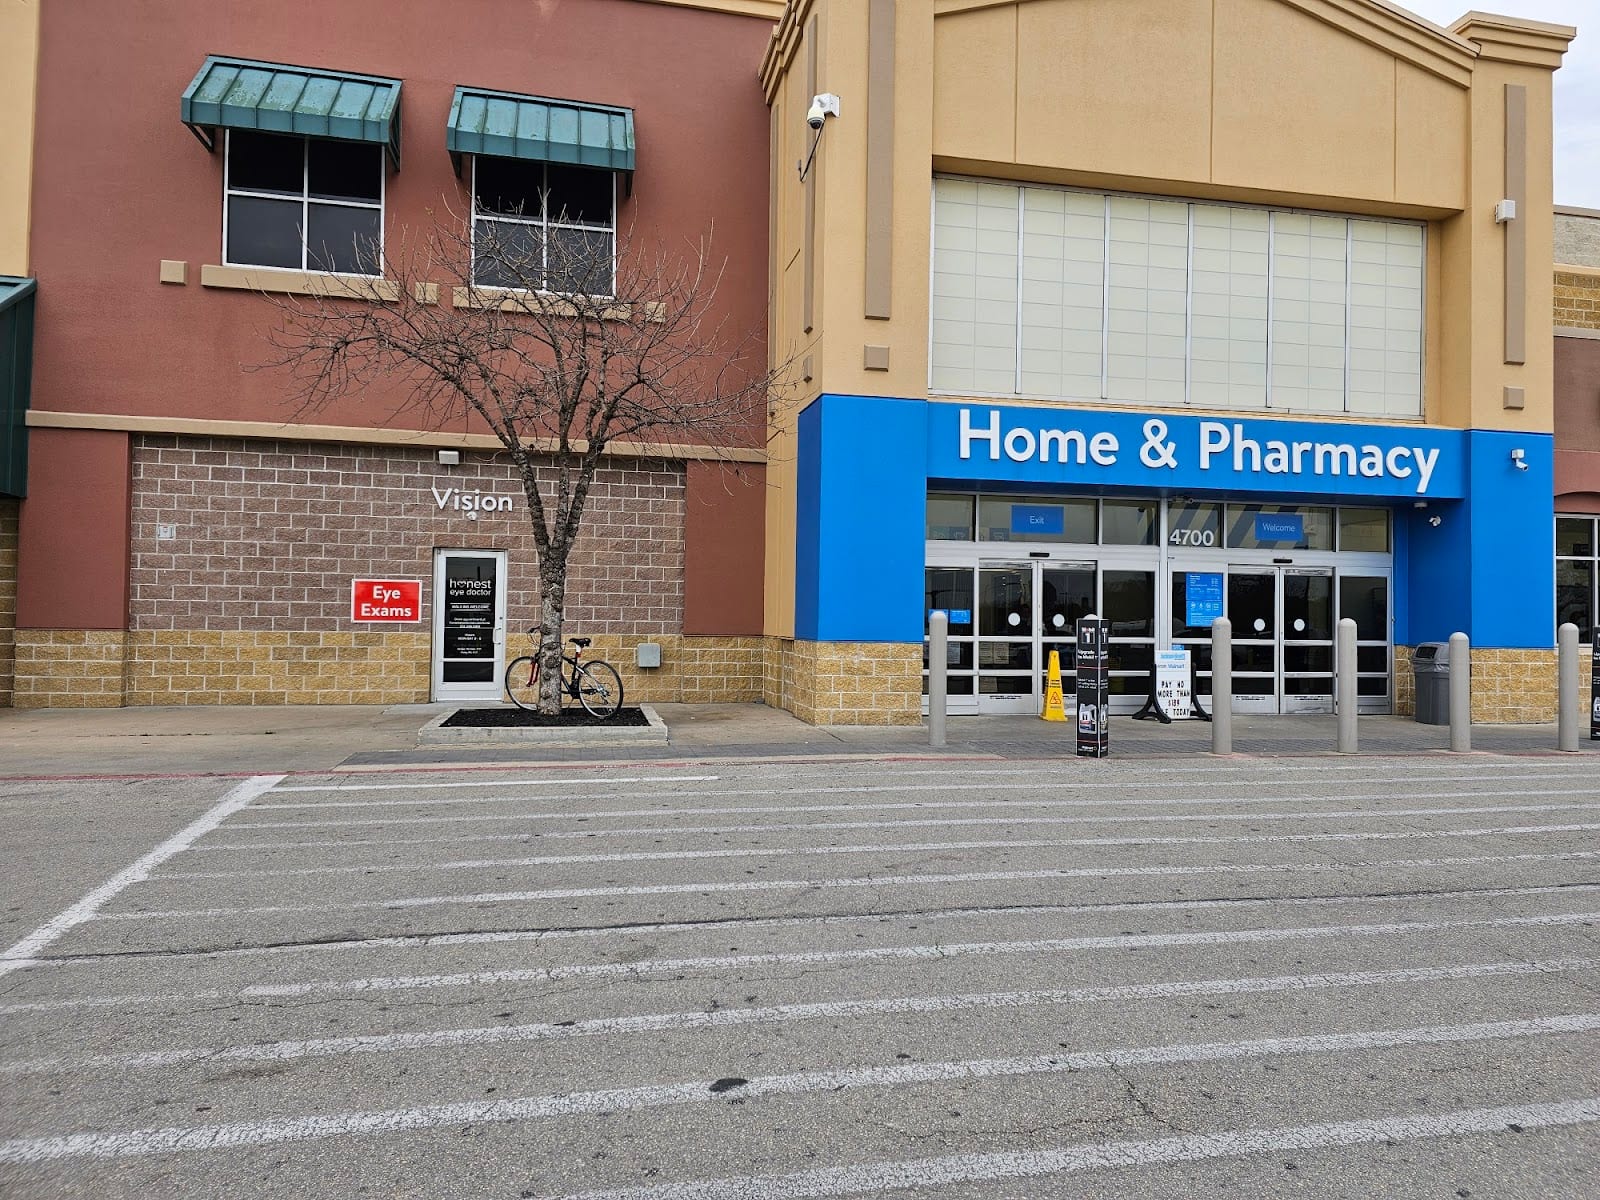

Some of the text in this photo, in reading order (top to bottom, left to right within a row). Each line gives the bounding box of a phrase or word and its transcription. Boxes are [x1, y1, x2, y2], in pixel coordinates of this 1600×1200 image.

[959, 408, 1440, 494] Home & Pharmacy
[431, 487, 513, 512] Vision
[1029, 515, 1045, 525] Exit
[1262, 522, 1296, 532] Welcome
[1169, 528, 1215, 546] 4700
[373, 585, 401, 603] Eye
[361, 603, 412, 617] Exams
[1161, 680, 1185, 689] PAY NO
[1157, 690, 1190, 698] MORE THAN
[1173, 708, 1190, 716] TODAY
